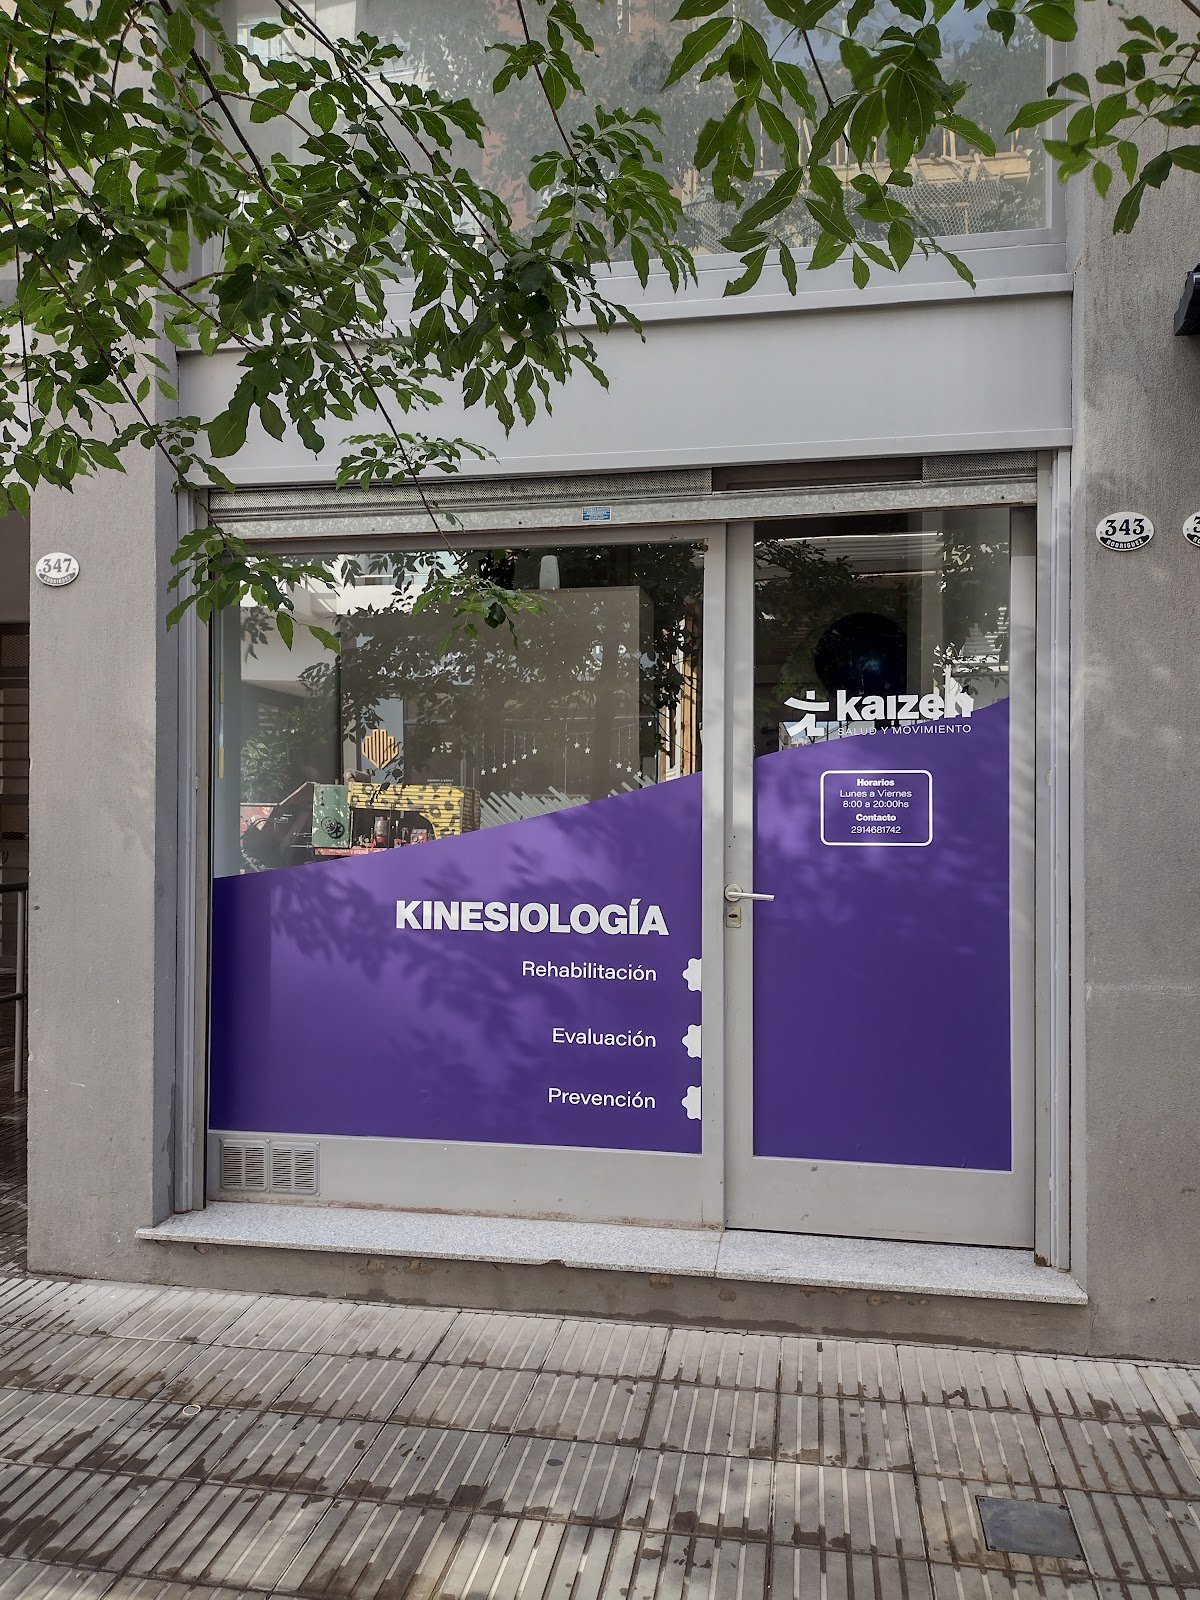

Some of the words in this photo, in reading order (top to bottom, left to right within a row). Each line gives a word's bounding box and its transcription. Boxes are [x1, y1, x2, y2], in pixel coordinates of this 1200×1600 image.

[1105, 518, 1145, 536] 343
[1106, 538, 1144, 549] RODRIGUEZ
[43, 558, 72, 573] 347
[837, 727, 877, 736] SALUD
[881, 726, 889, 735] Y
[892, 724, 972, 735] MOVIMIENTO
[856, 778, 896, 787] Horarios
[839, 789, 868, 798] Lunes
[877, 788, 913, 798] Viernes
[842, 799, 863, 808] 8:00
[872, 799, 910, 808] 20:00hs
[855, 812, 897, 822] Contacto
[850, 825, 902, 834] 2914681742
[395, 898, 670, 936] KINESIOLOGÍA
[521, 960, 657, 982] Rehabilitación
[551, 1027, 657, 1048] Evaluación
[548, 1087, 656, 1109] Prevención
